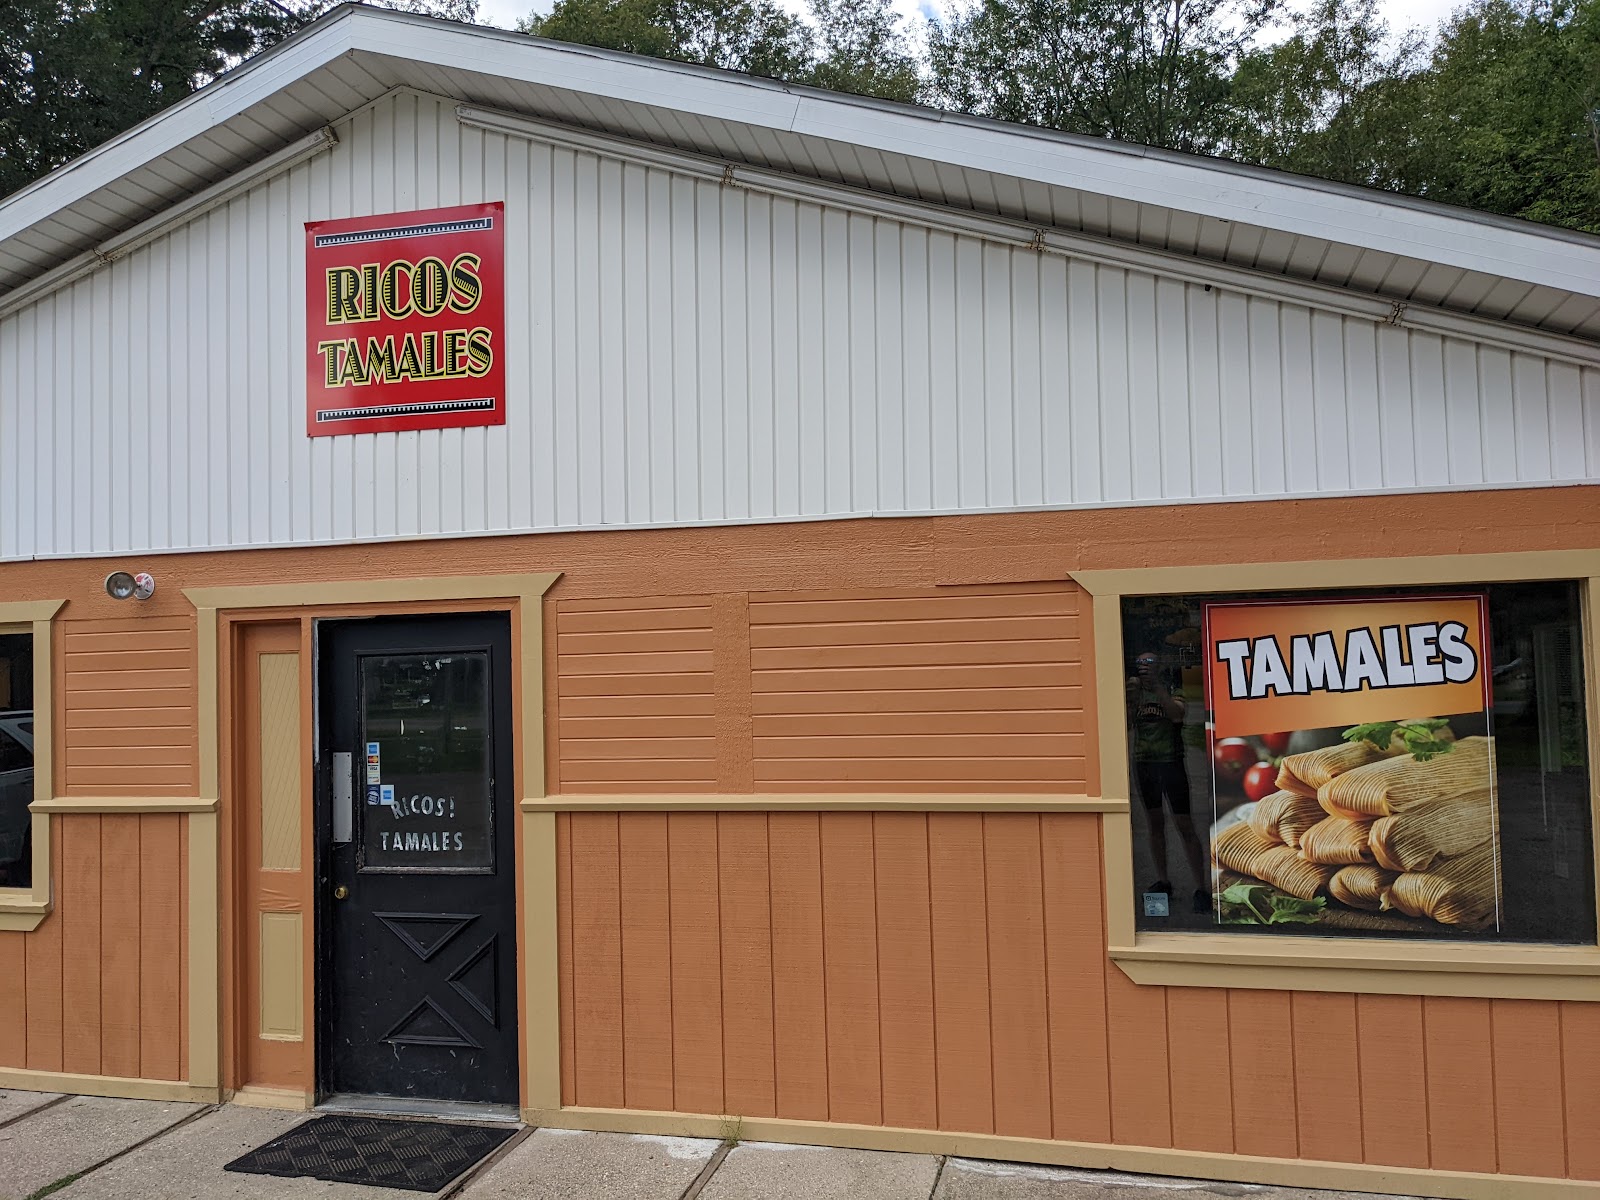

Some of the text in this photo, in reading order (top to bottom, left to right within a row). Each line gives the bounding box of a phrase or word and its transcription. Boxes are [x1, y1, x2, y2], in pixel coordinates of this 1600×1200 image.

[325, 252, 482, 325] RICOS
[317, 326, 493, 388] TAMALES
[1216, 620, 1478, 700] TAMALES
[390, 794, 455, 820] RICOS!
[380, 831, 463, 852] TAMALES
